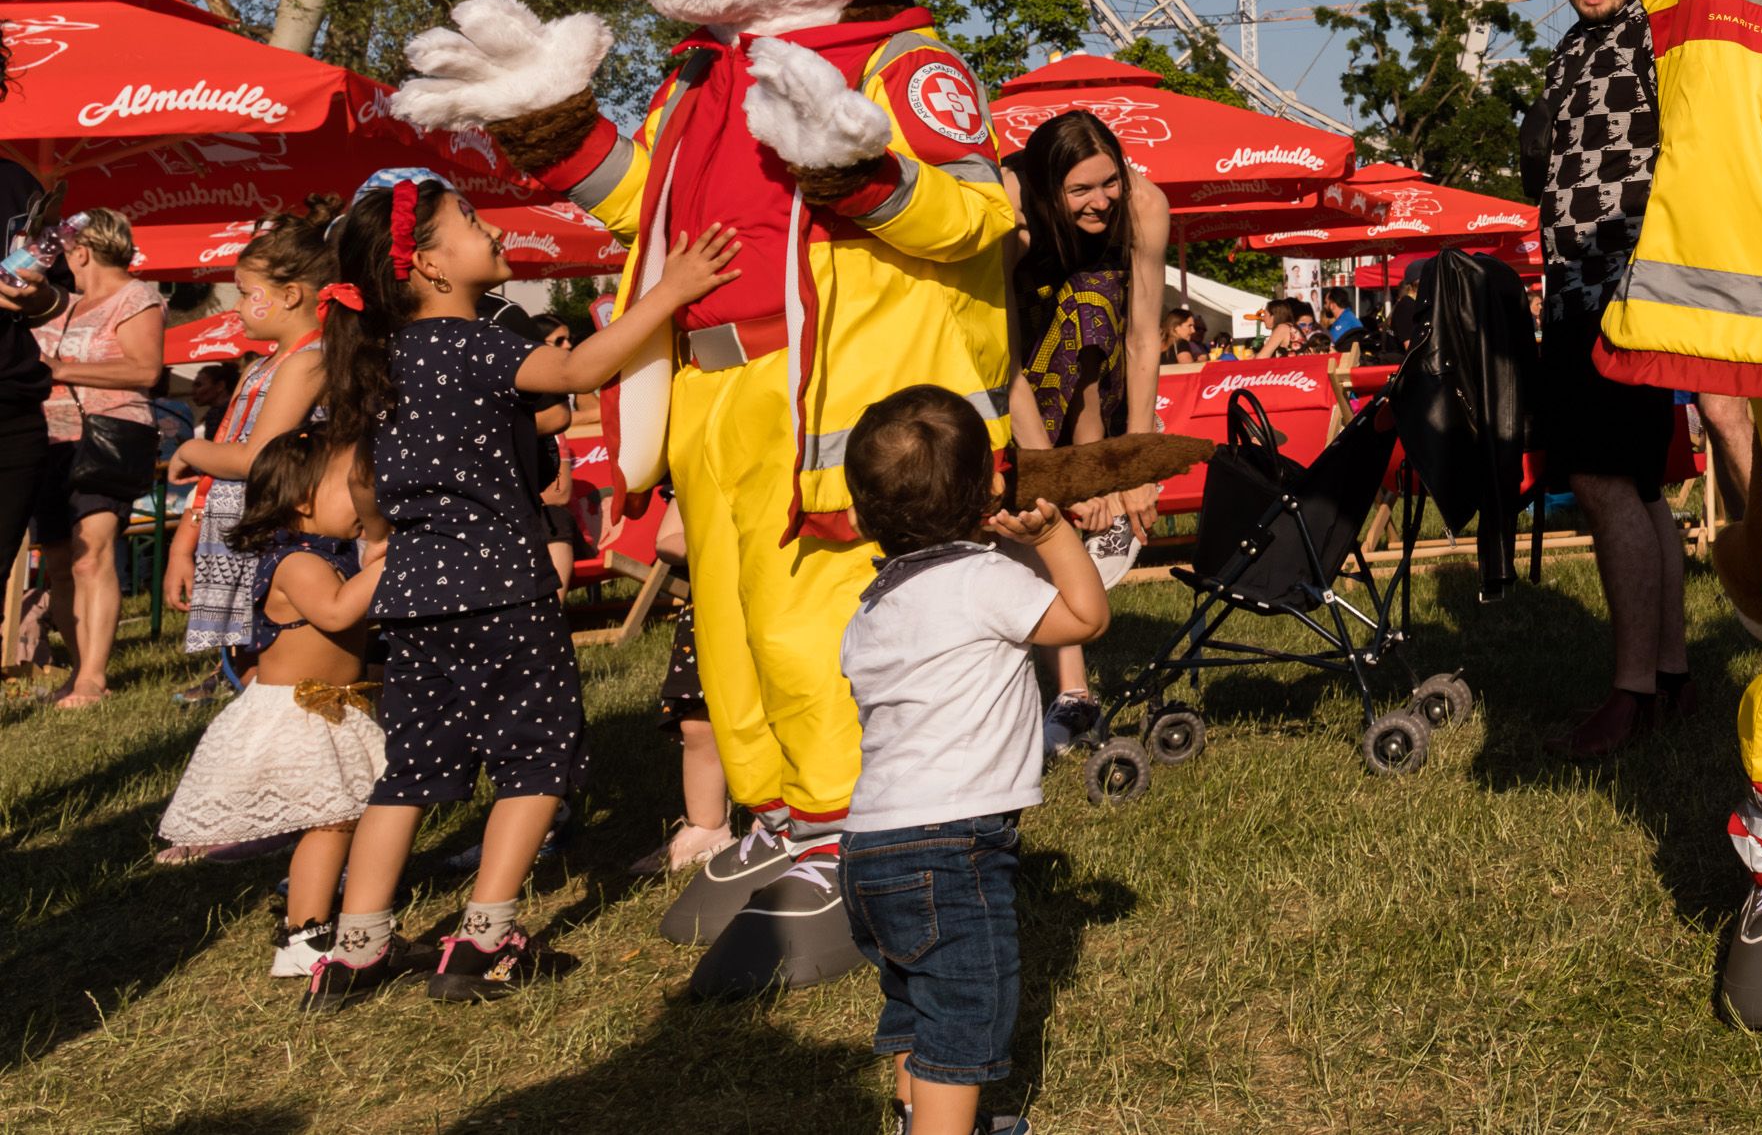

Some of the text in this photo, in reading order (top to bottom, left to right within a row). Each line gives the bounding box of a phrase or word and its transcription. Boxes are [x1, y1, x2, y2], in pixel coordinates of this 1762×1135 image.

[77, 79, 288, 127] Almdudler
[910, 77, 931, 119] ARBEITER
[1215, 144, 1326, 174] Almdudler
[1466, 212, 1528, 231] Almdudler
[1201, 370, 1318, 400] Almdudler
